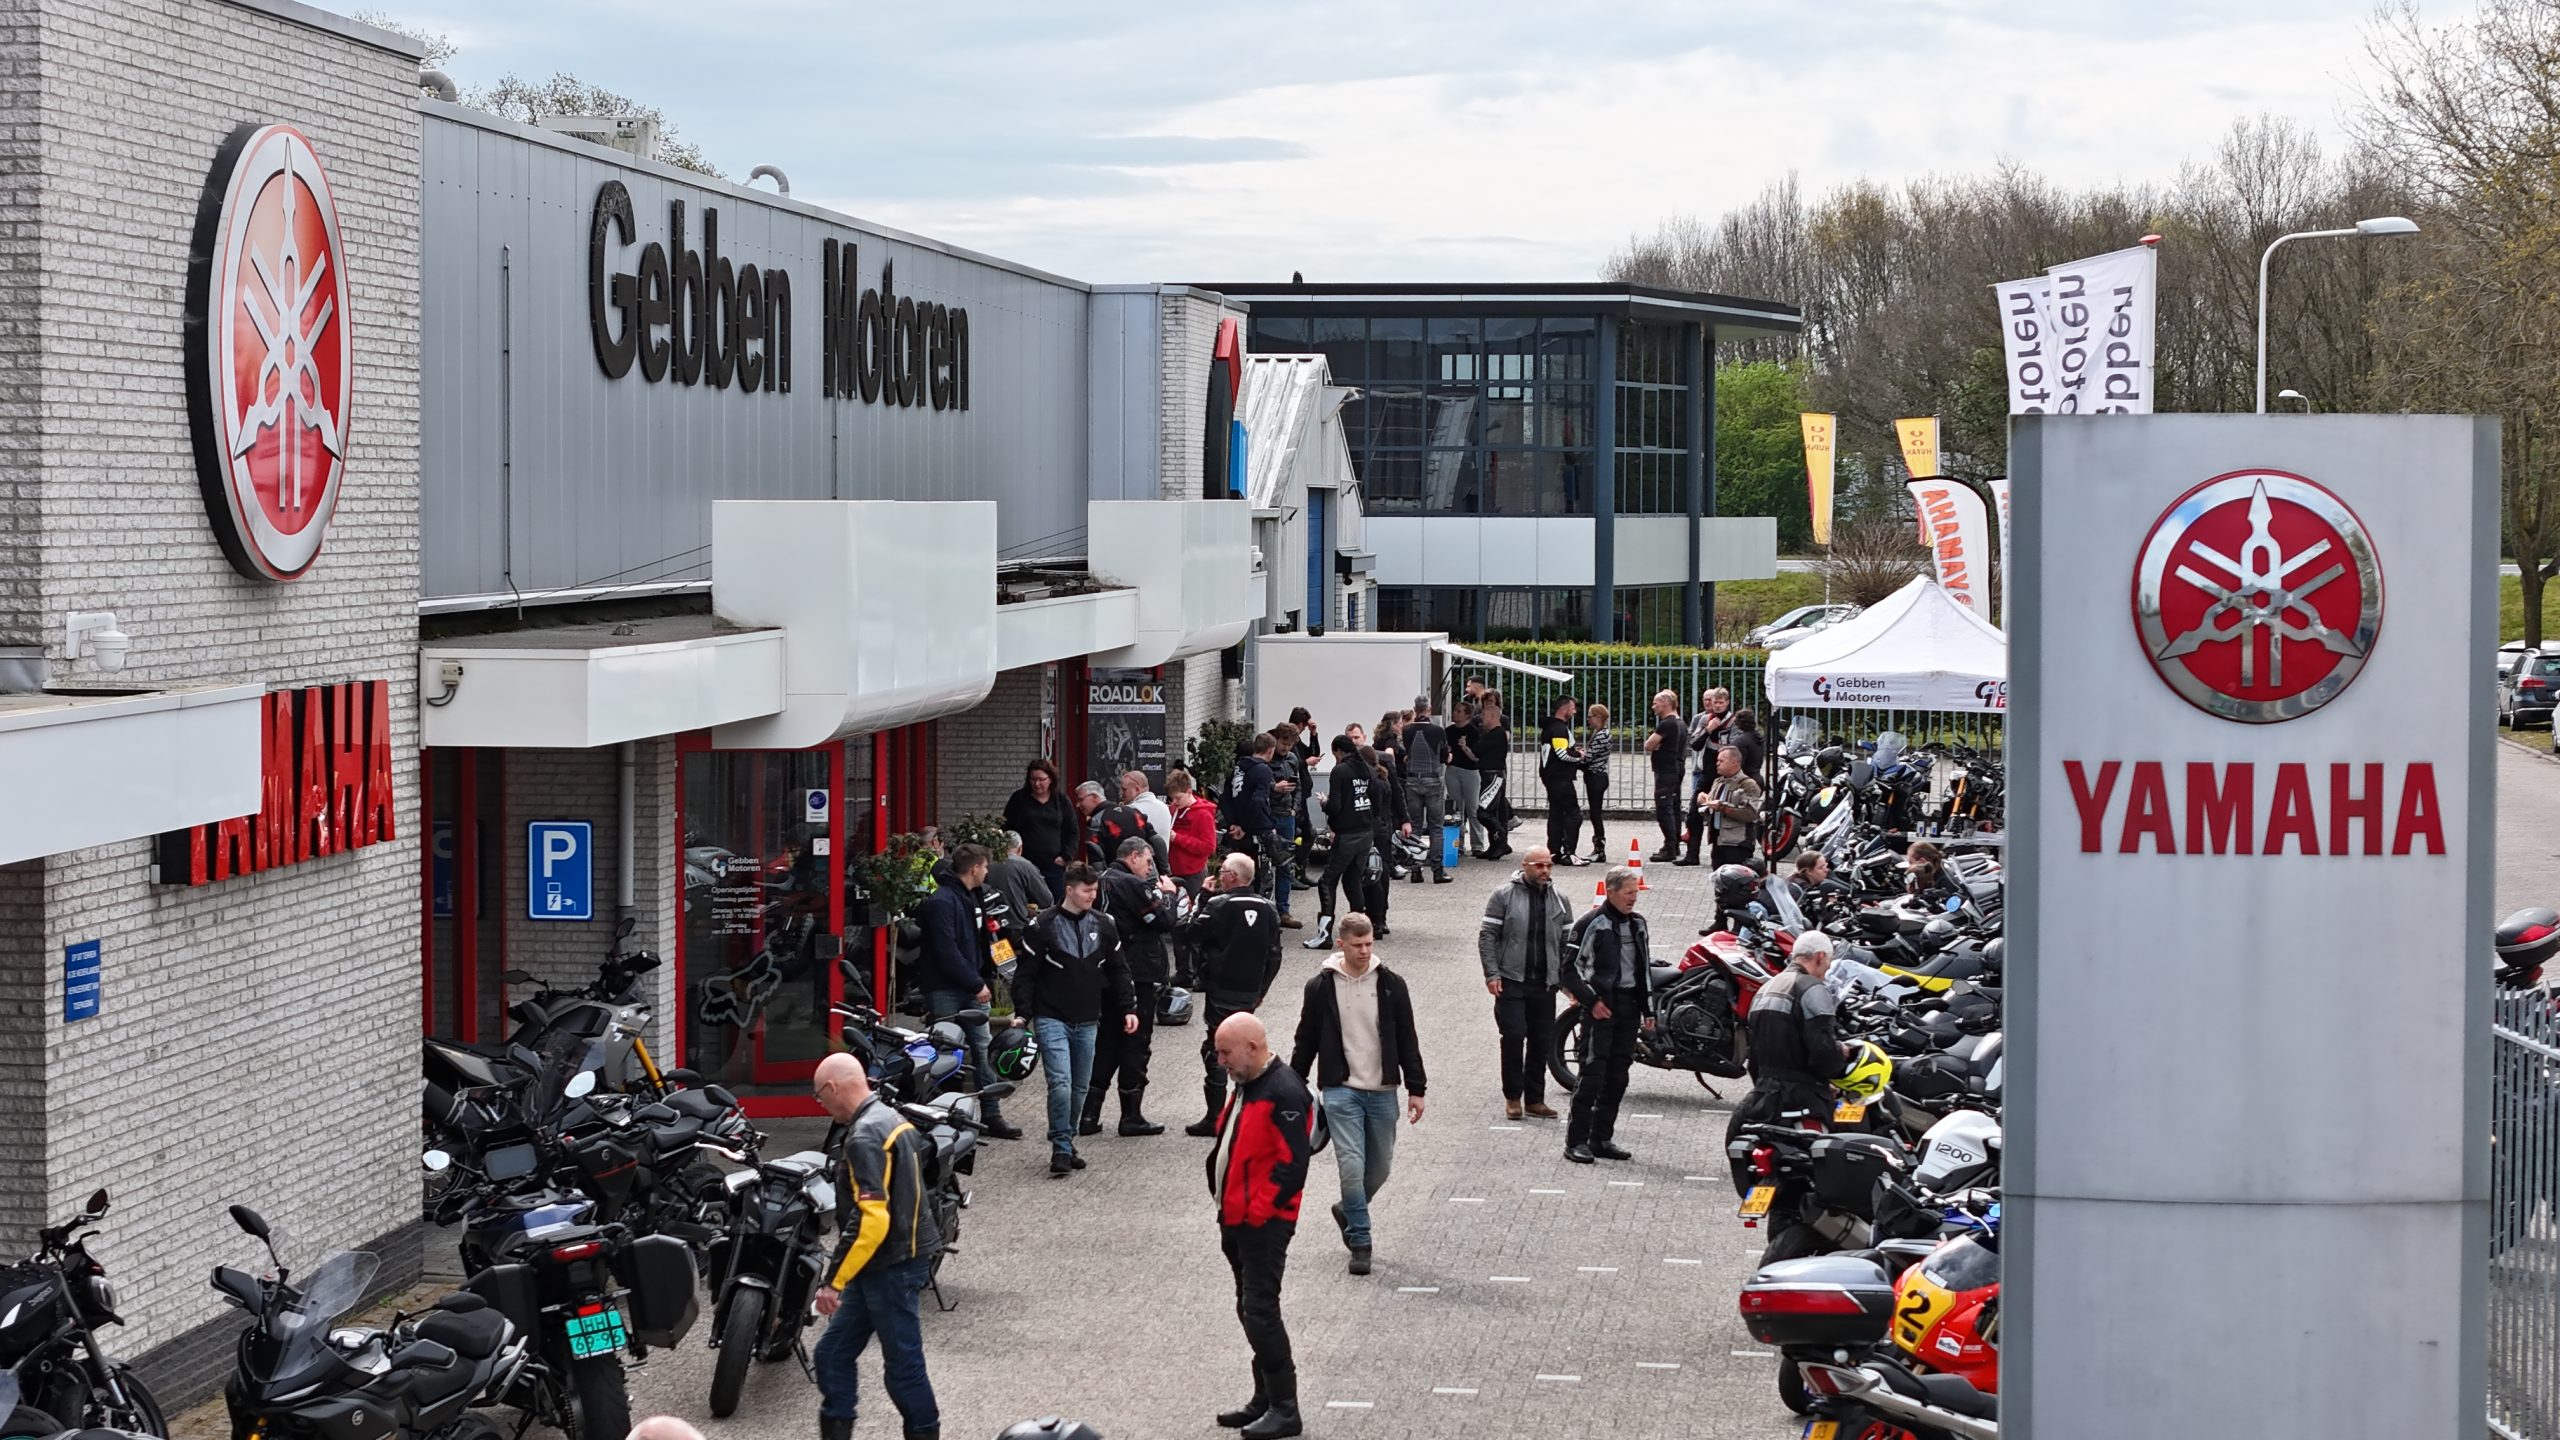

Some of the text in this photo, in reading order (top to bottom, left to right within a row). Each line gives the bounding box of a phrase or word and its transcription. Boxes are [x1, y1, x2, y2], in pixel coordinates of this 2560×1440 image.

[590, 179, 969, 411] Gebben Motoren
[1836, 677, 1885, 689] Gebben
[1089, 685, 1164, 703] ROADLOK
[1835, 692, 1891, 703] Motoren
[2063, 760, 2447, 856] YAMAHA
[543, 830, 577, 878] P
[727, 856, 760, 864] Gebben
[727, 864, 761, 872] Motoren
[1934, 1142, 1973, 1163] 1200
[1898, 1289, 1932, 1331] 2
[583, 1314, 607, 1332] HH
